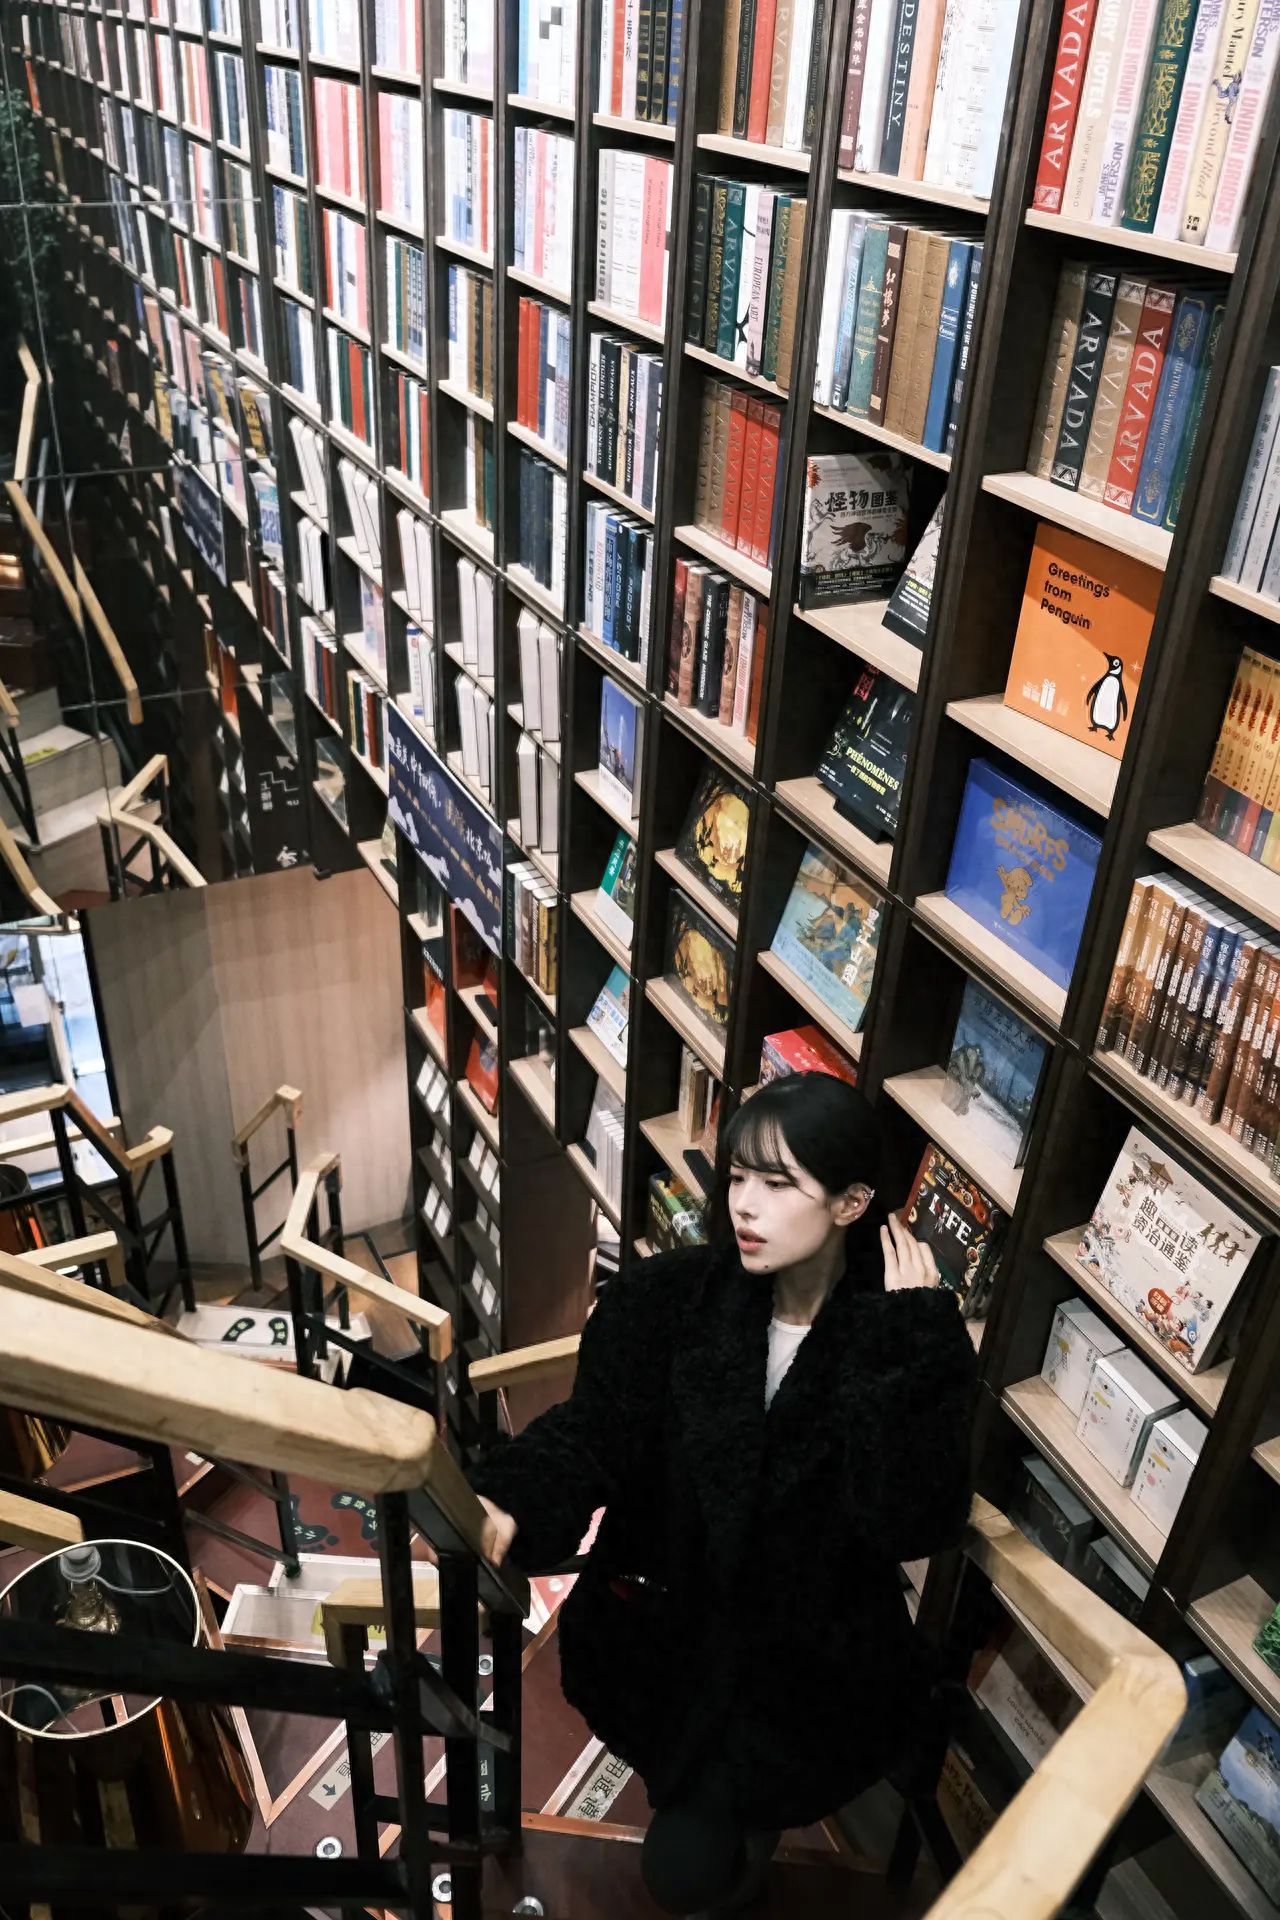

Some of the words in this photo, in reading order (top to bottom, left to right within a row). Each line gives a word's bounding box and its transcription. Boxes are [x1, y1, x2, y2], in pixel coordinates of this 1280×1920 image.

[891, 3, 916, 127] DESTINY
[1044, 3, 1089, 170] ARVADA
[1099, 141, 1127, 218] PATTERSON
[721, 217, 738, 332] ARVADA
[751, 256, 763, 302] EUROPEAN
[749, 302, 760, 323] ART
[589, 362, 598, 429] CHAMPION
[1060, 309, 1103, 450] ARVADA
[1090, 318, 1133, 455] ARVADA
[1116, 326, 1164, 473] ARVADA
[824, 489, 898, 512] 怪物图鉴
[625, 576, 634, 632] PRODIGY
[1043, 579, 1072, 602] from
[1048, 562, 1110, 598] Greetings
[1040, 598, 1091, 630] Penguin
[1132, 1212, 1193, 1274] 资治通鉴
